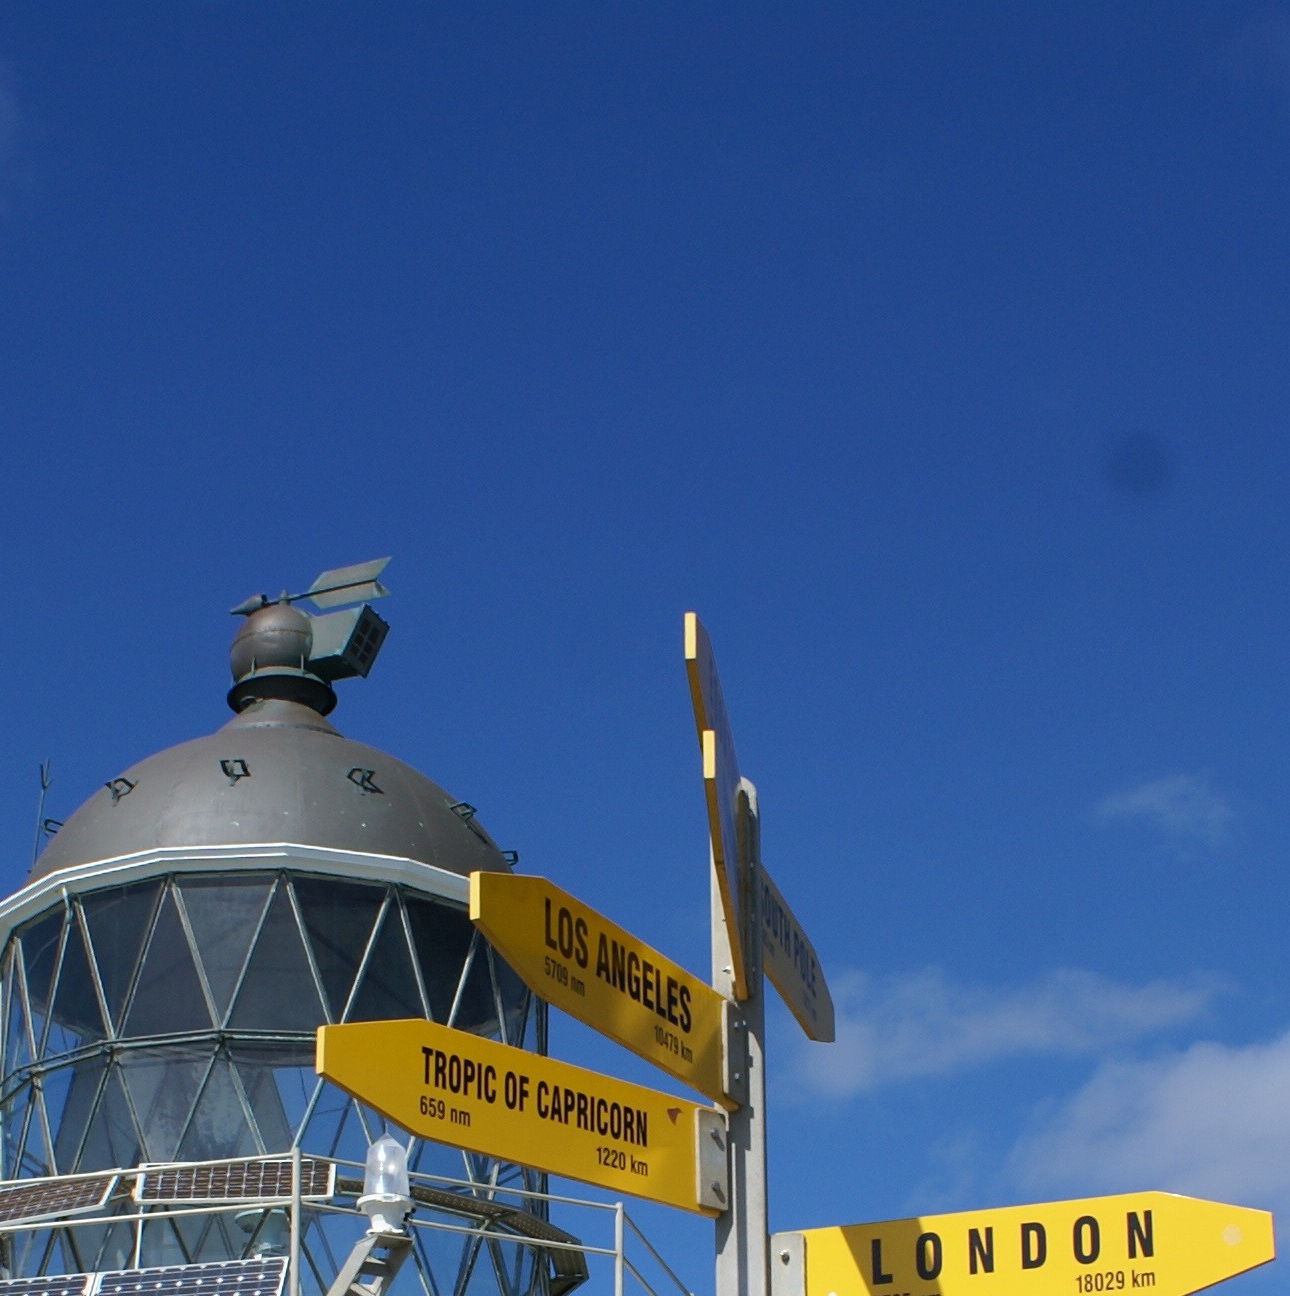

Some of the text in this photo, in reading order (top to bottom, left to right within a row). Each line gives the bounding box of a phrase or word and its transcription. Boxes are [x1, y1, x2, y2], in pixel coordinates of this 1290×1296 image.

[544, 897, 692, 1034] LOS ANGELES
[793, 929, 817, 999] POLE
[681, 1041, 693, 1063] km
[419, 1095, 471, 1127] 659 nm
[421, 1046, 649, 1147] TROPIC OF CAPRICORN
[596, 1146, 649, 1176] 1220 km
[871, 1209, 1155, 1286] LONDON
[1075, 1269, 1156, 1294] 18029 km
